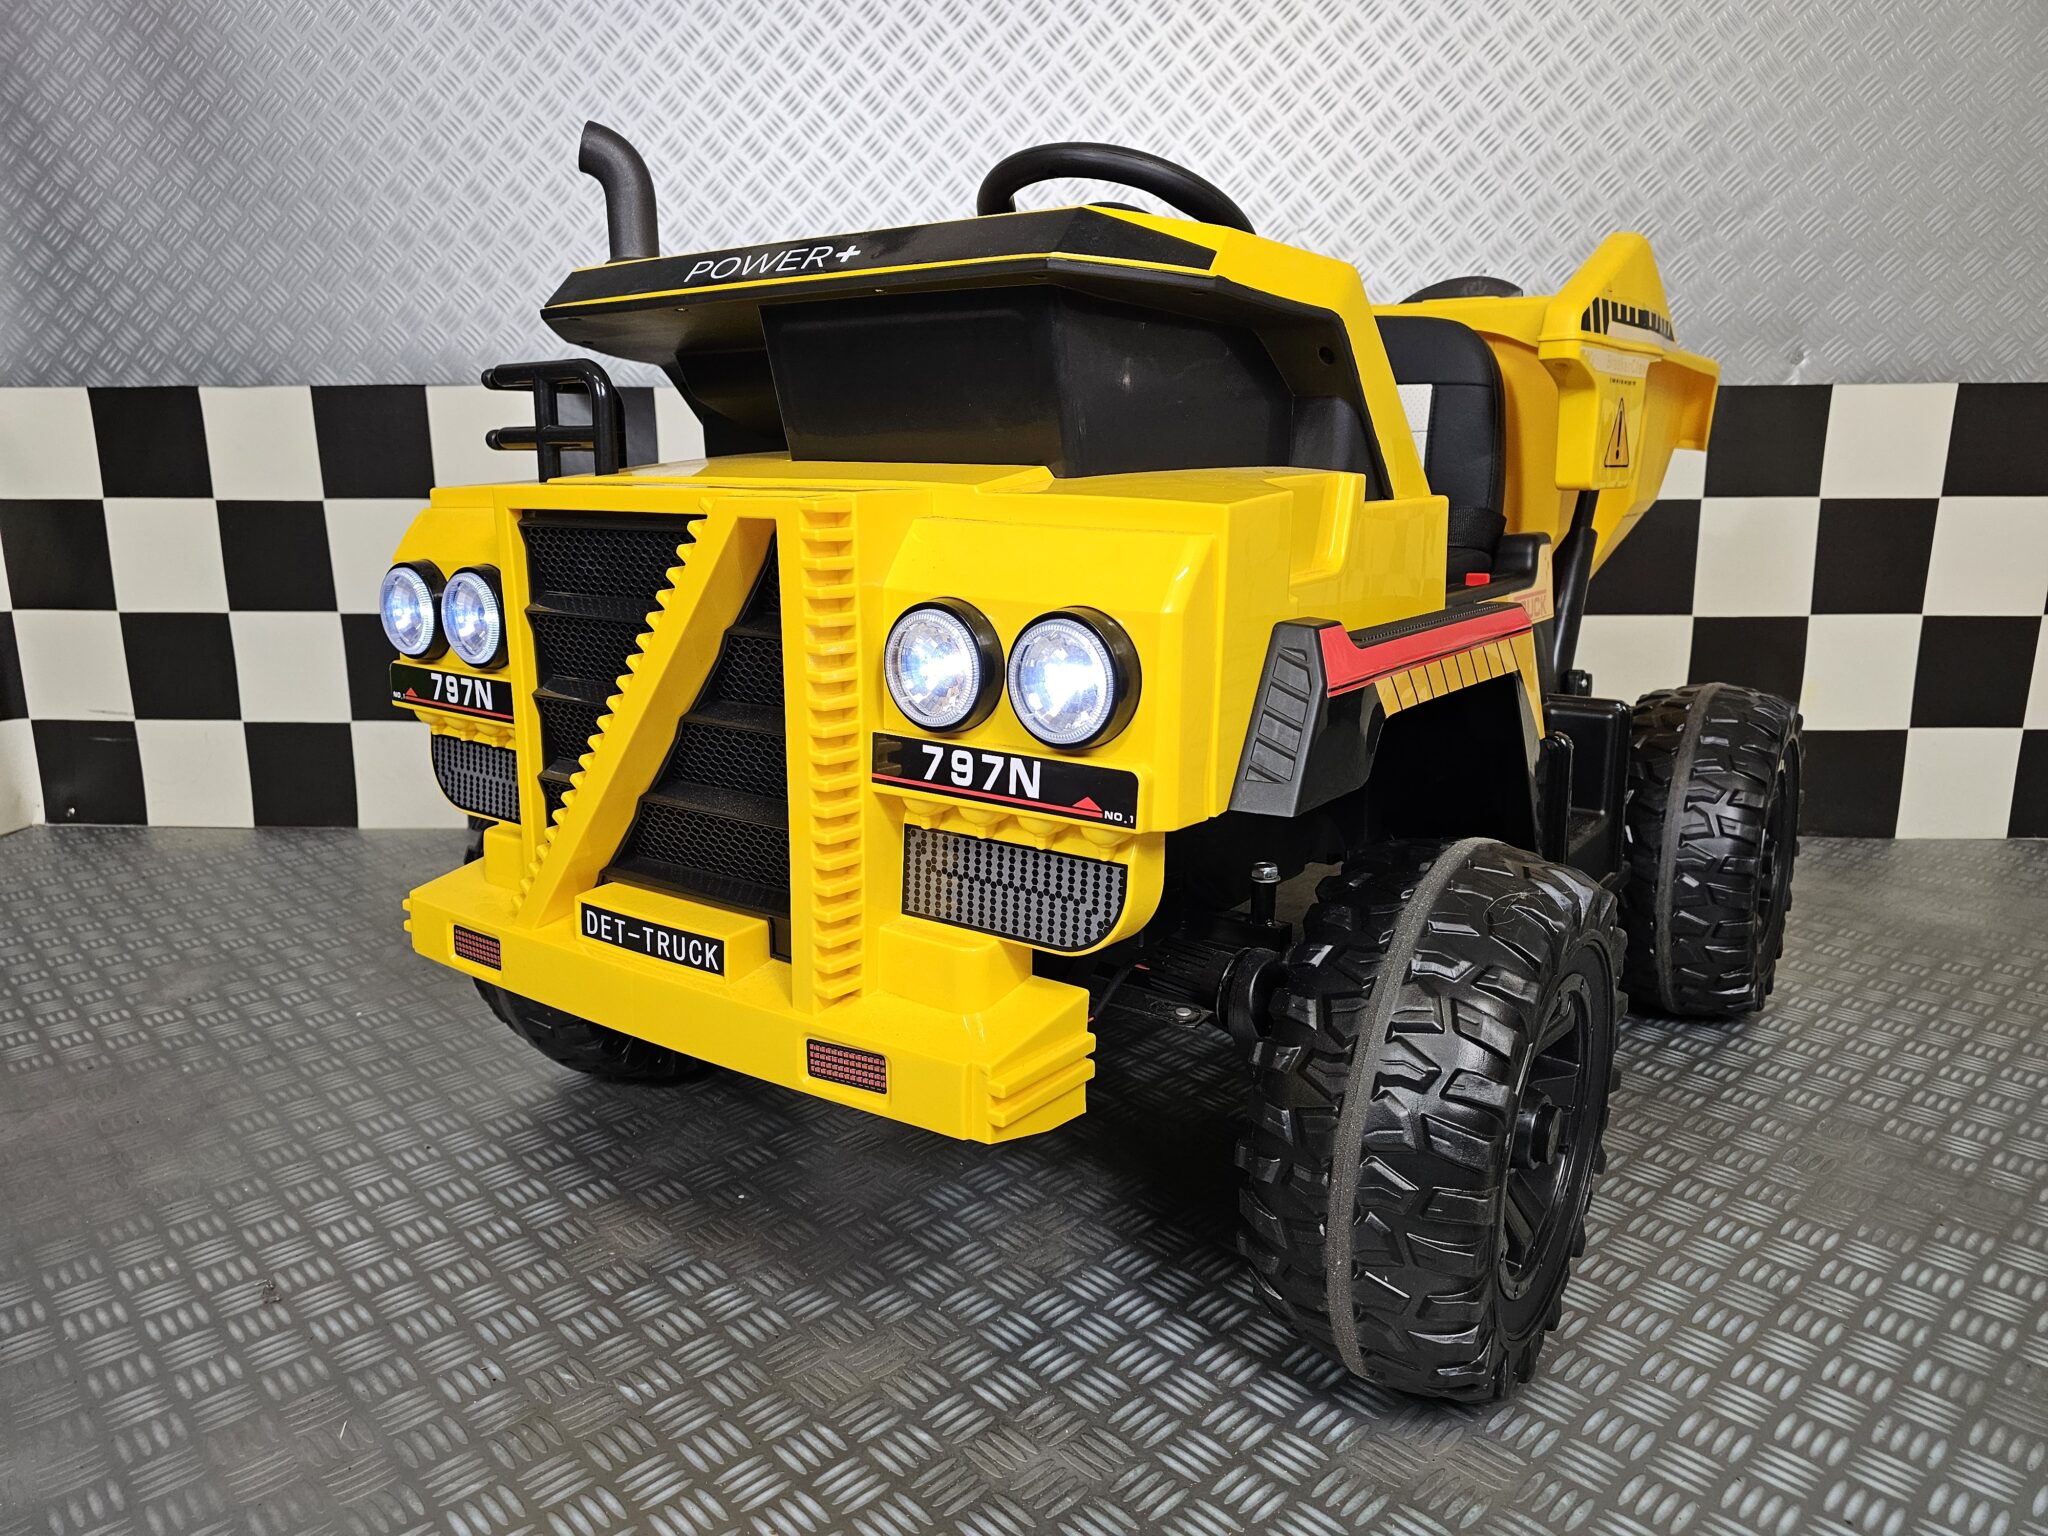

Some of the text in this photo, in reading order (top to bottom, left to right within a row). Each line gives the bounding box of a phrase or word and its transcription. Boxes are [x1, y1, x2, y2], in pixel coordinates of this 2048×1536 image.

[430, 672, 493, 711] 797N
[921, 744, 1042, 800] 797N
[1103, 810, 1134, 824] NO.1
[586, 909, 719, 971] DET-TRUCK
